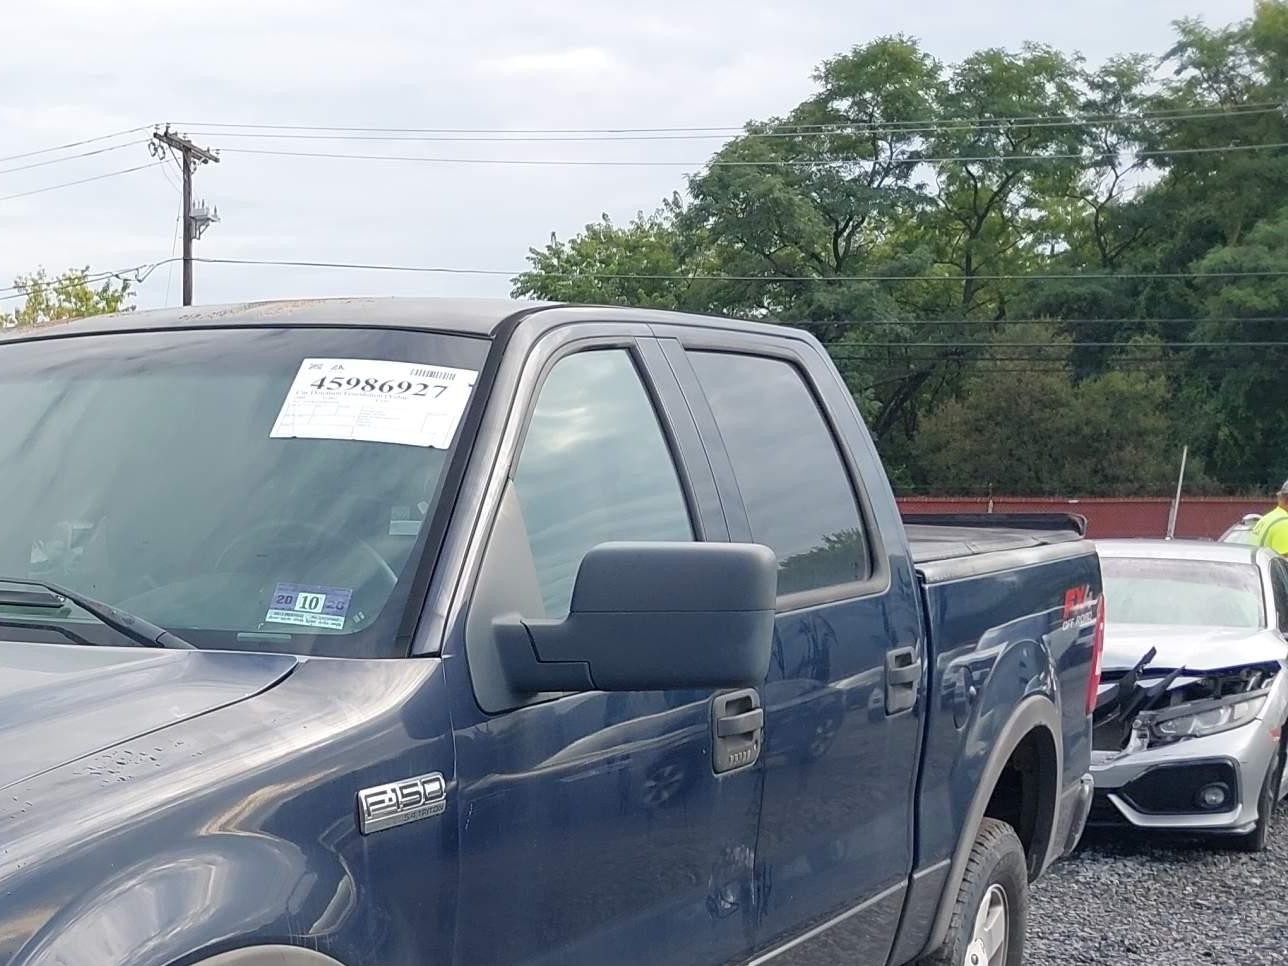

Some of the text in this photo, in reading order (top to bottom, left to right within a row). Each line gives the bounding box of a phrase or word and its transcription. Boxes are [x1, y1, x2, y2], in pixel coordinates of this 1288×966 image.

[310, 376, 448, 399] 45986927
[299, 595, 320, 610] 10
[364, 777, 444, 818] F-150
